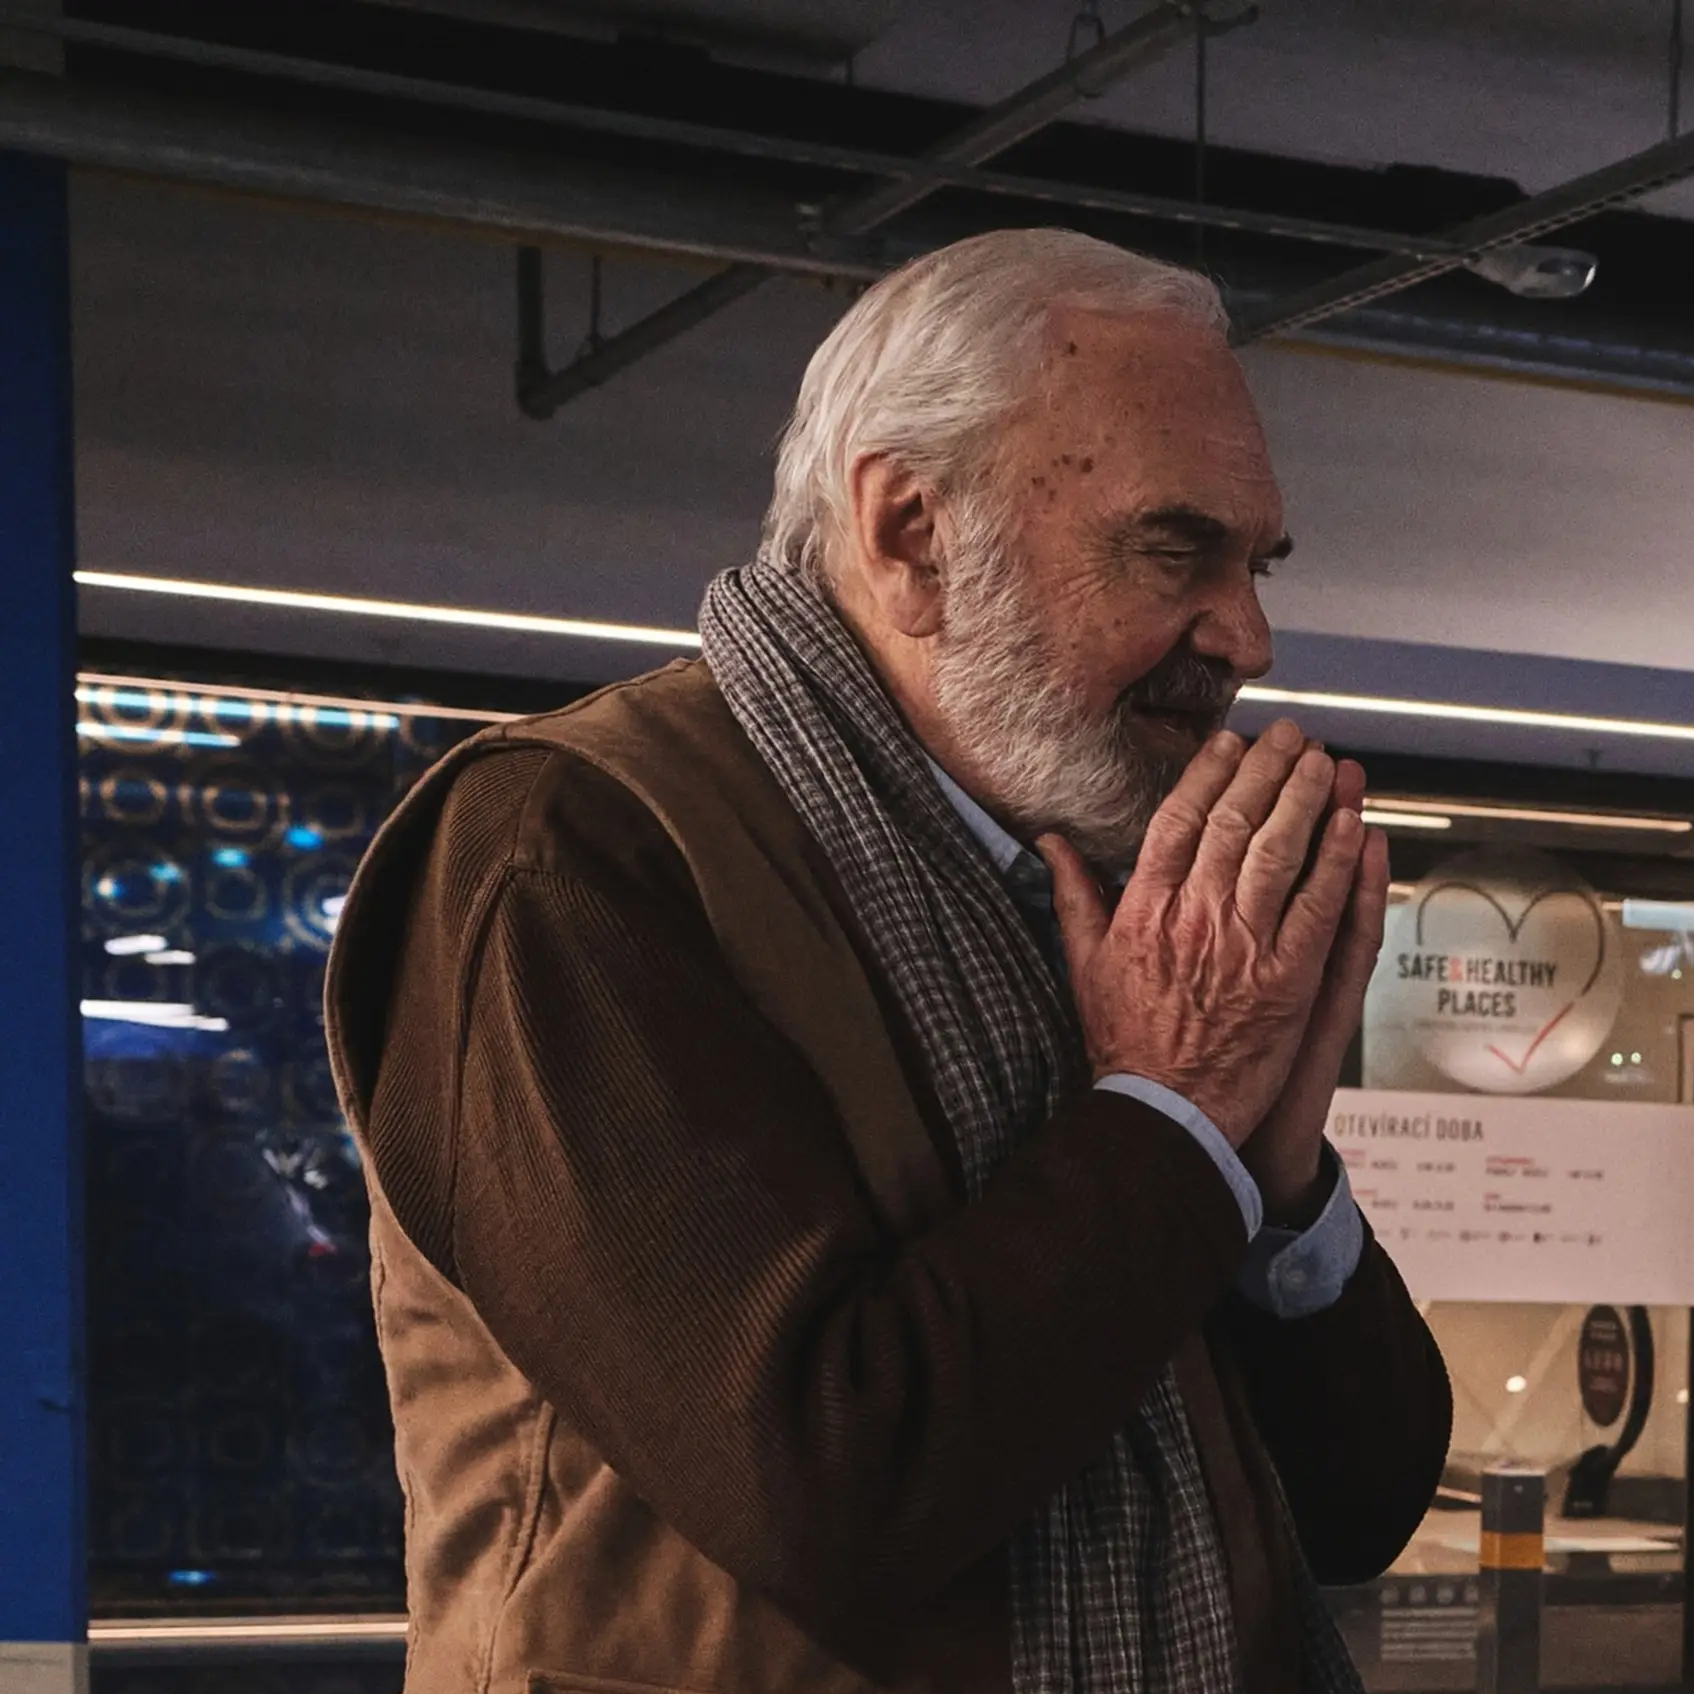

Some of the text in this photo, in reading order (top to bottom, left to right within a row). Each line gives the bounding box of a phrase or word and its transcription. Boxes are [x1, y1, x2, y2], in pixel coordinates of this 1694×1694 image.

[1436, 988, 1517, 1018] PLACES
[1334, 1110, 1484, 1141] OTEVÍRACÍ DOBA
